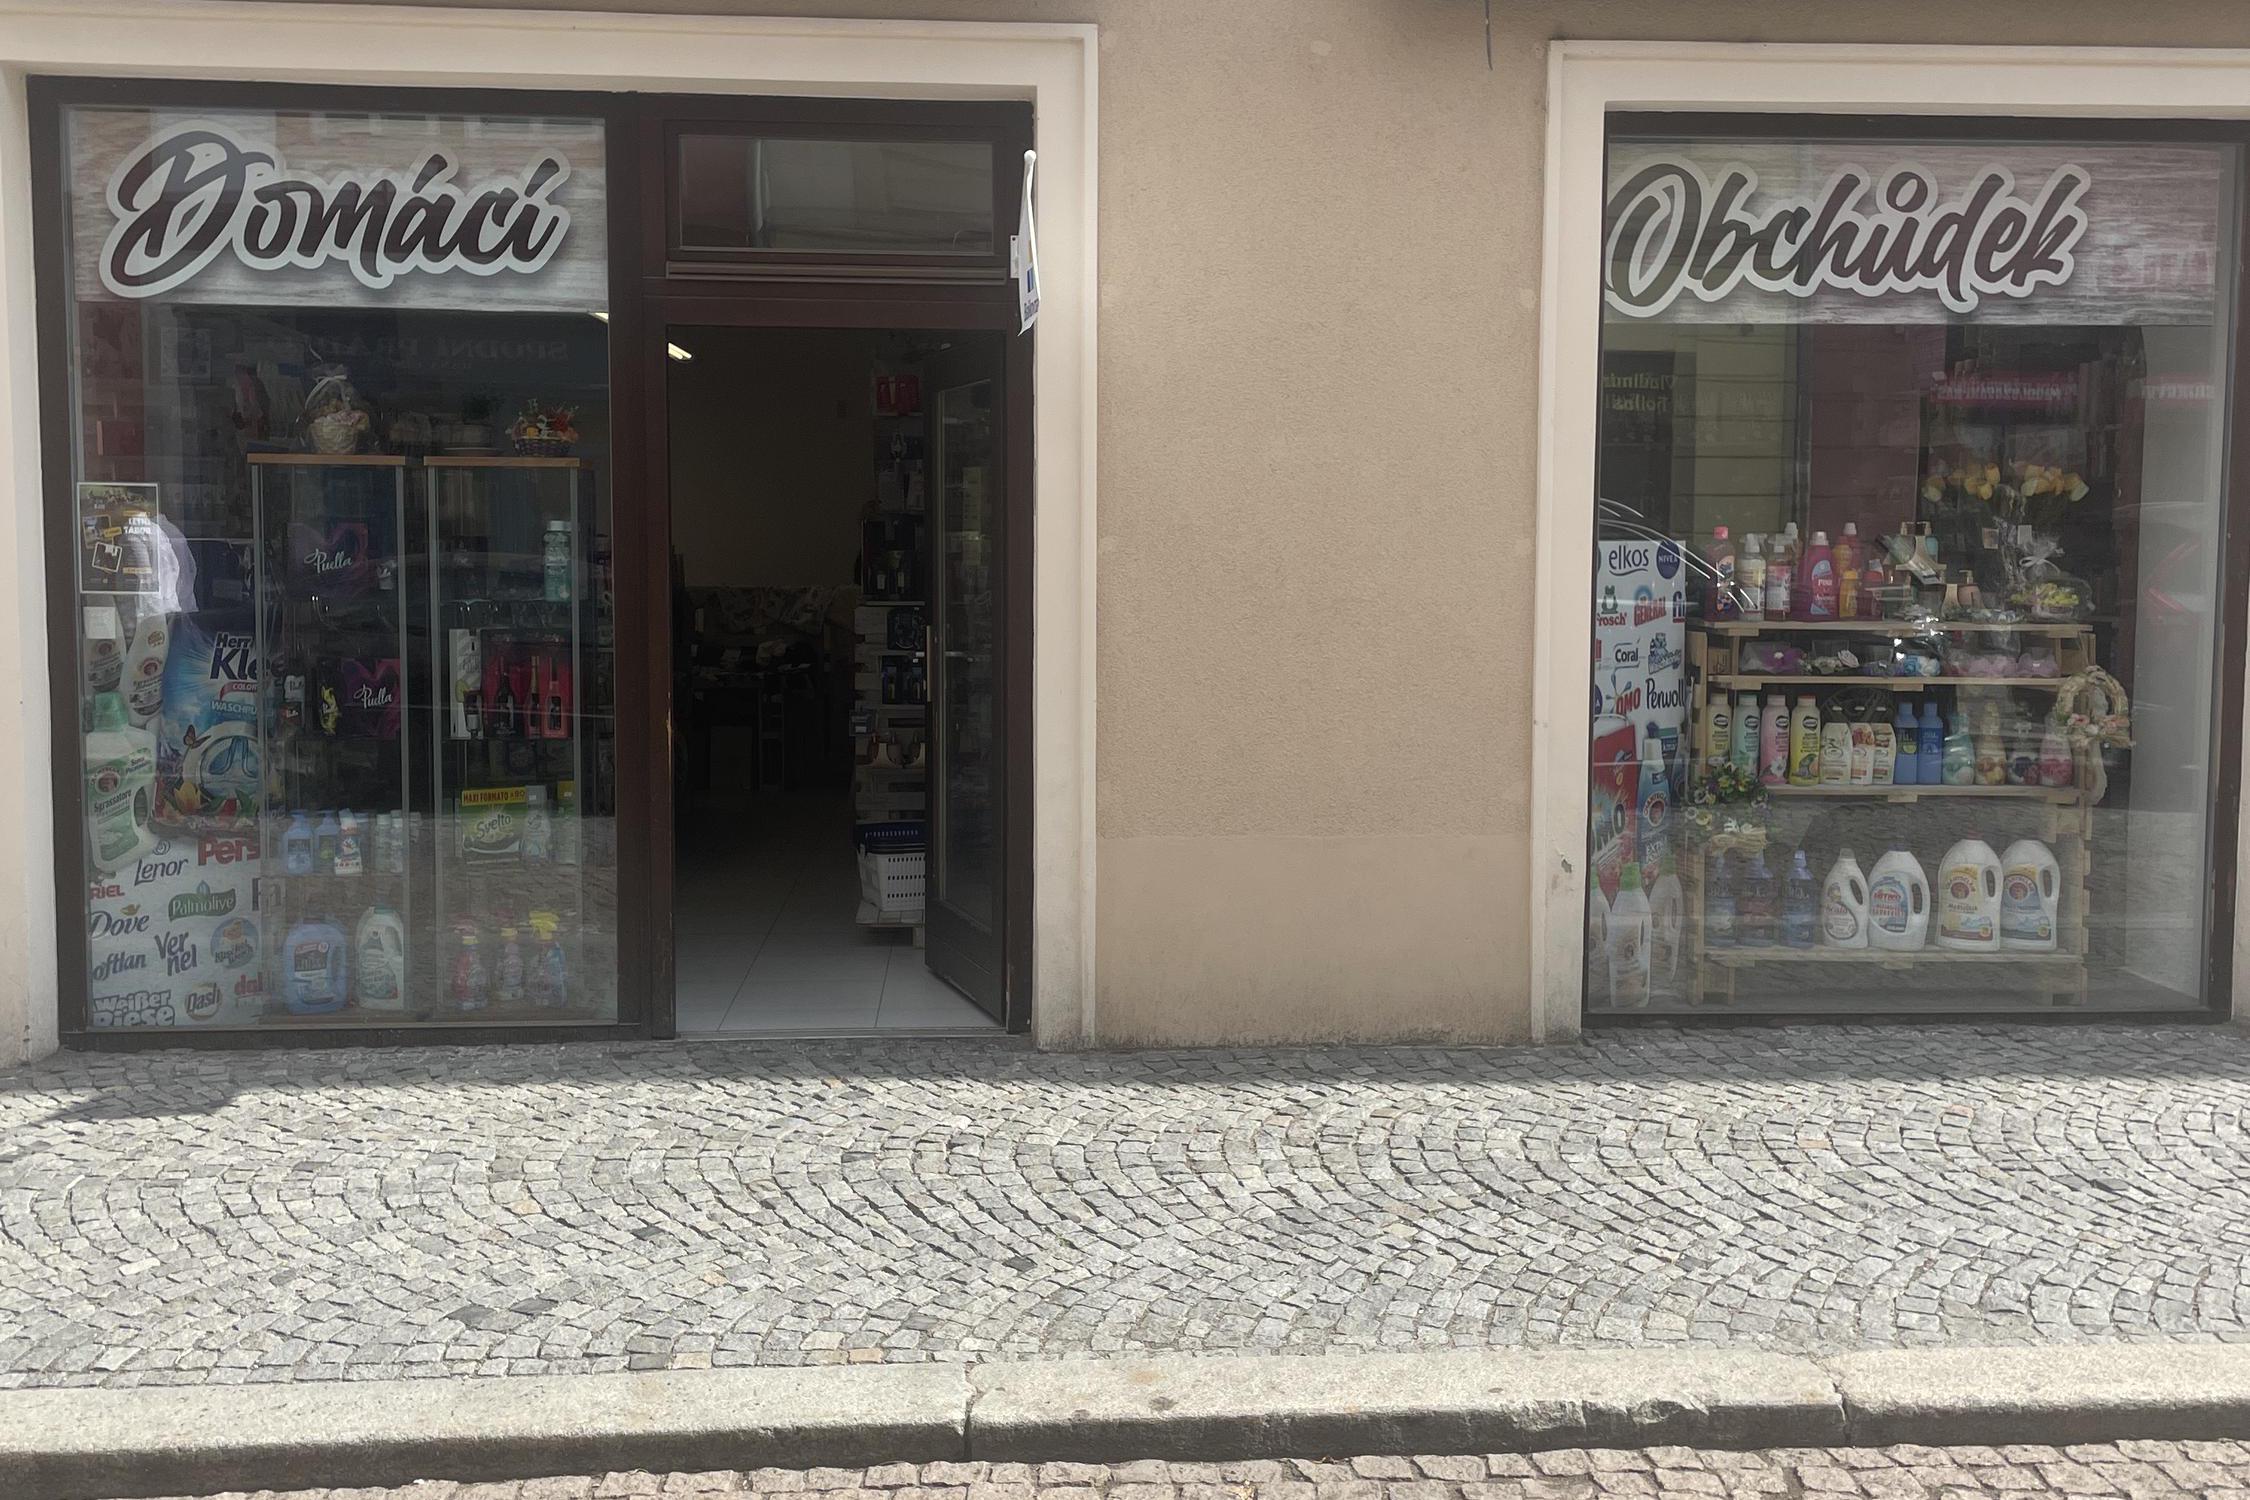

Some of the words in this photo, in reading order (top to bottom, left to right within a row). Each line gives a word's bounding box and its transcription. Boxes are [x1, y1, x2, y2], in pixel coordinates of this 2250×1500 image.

[106, 125, 566, 292] Domácí
[1606, 158, 2085, 311] Obchůdek
[304, 548, 352, 573] Puella
[1609, 544, 1649, 570] elkos
[1657, 554, 1678, 563] NIVEA
[1596, 611, 1627, 627] rosch
[216, 632, 253, 648] Herr
[1615, 647, 1639, 662] Coral
[353, 682, 392, 710] Puella
[1615, 687, 1641, 716] OMO
[1645, 677, 1686, 710] Perwoll
[476, 813, 511, 840] Svelto
[134, 857, 189, 886] Lenor
[171, 895, 235, 915] Palmolive
[88, 910, 150, 939] Dove
[154, 931, 189, 960] Ver
[167, 944, 197, 976] nel
[186, 982, 220, 1014] Dash
